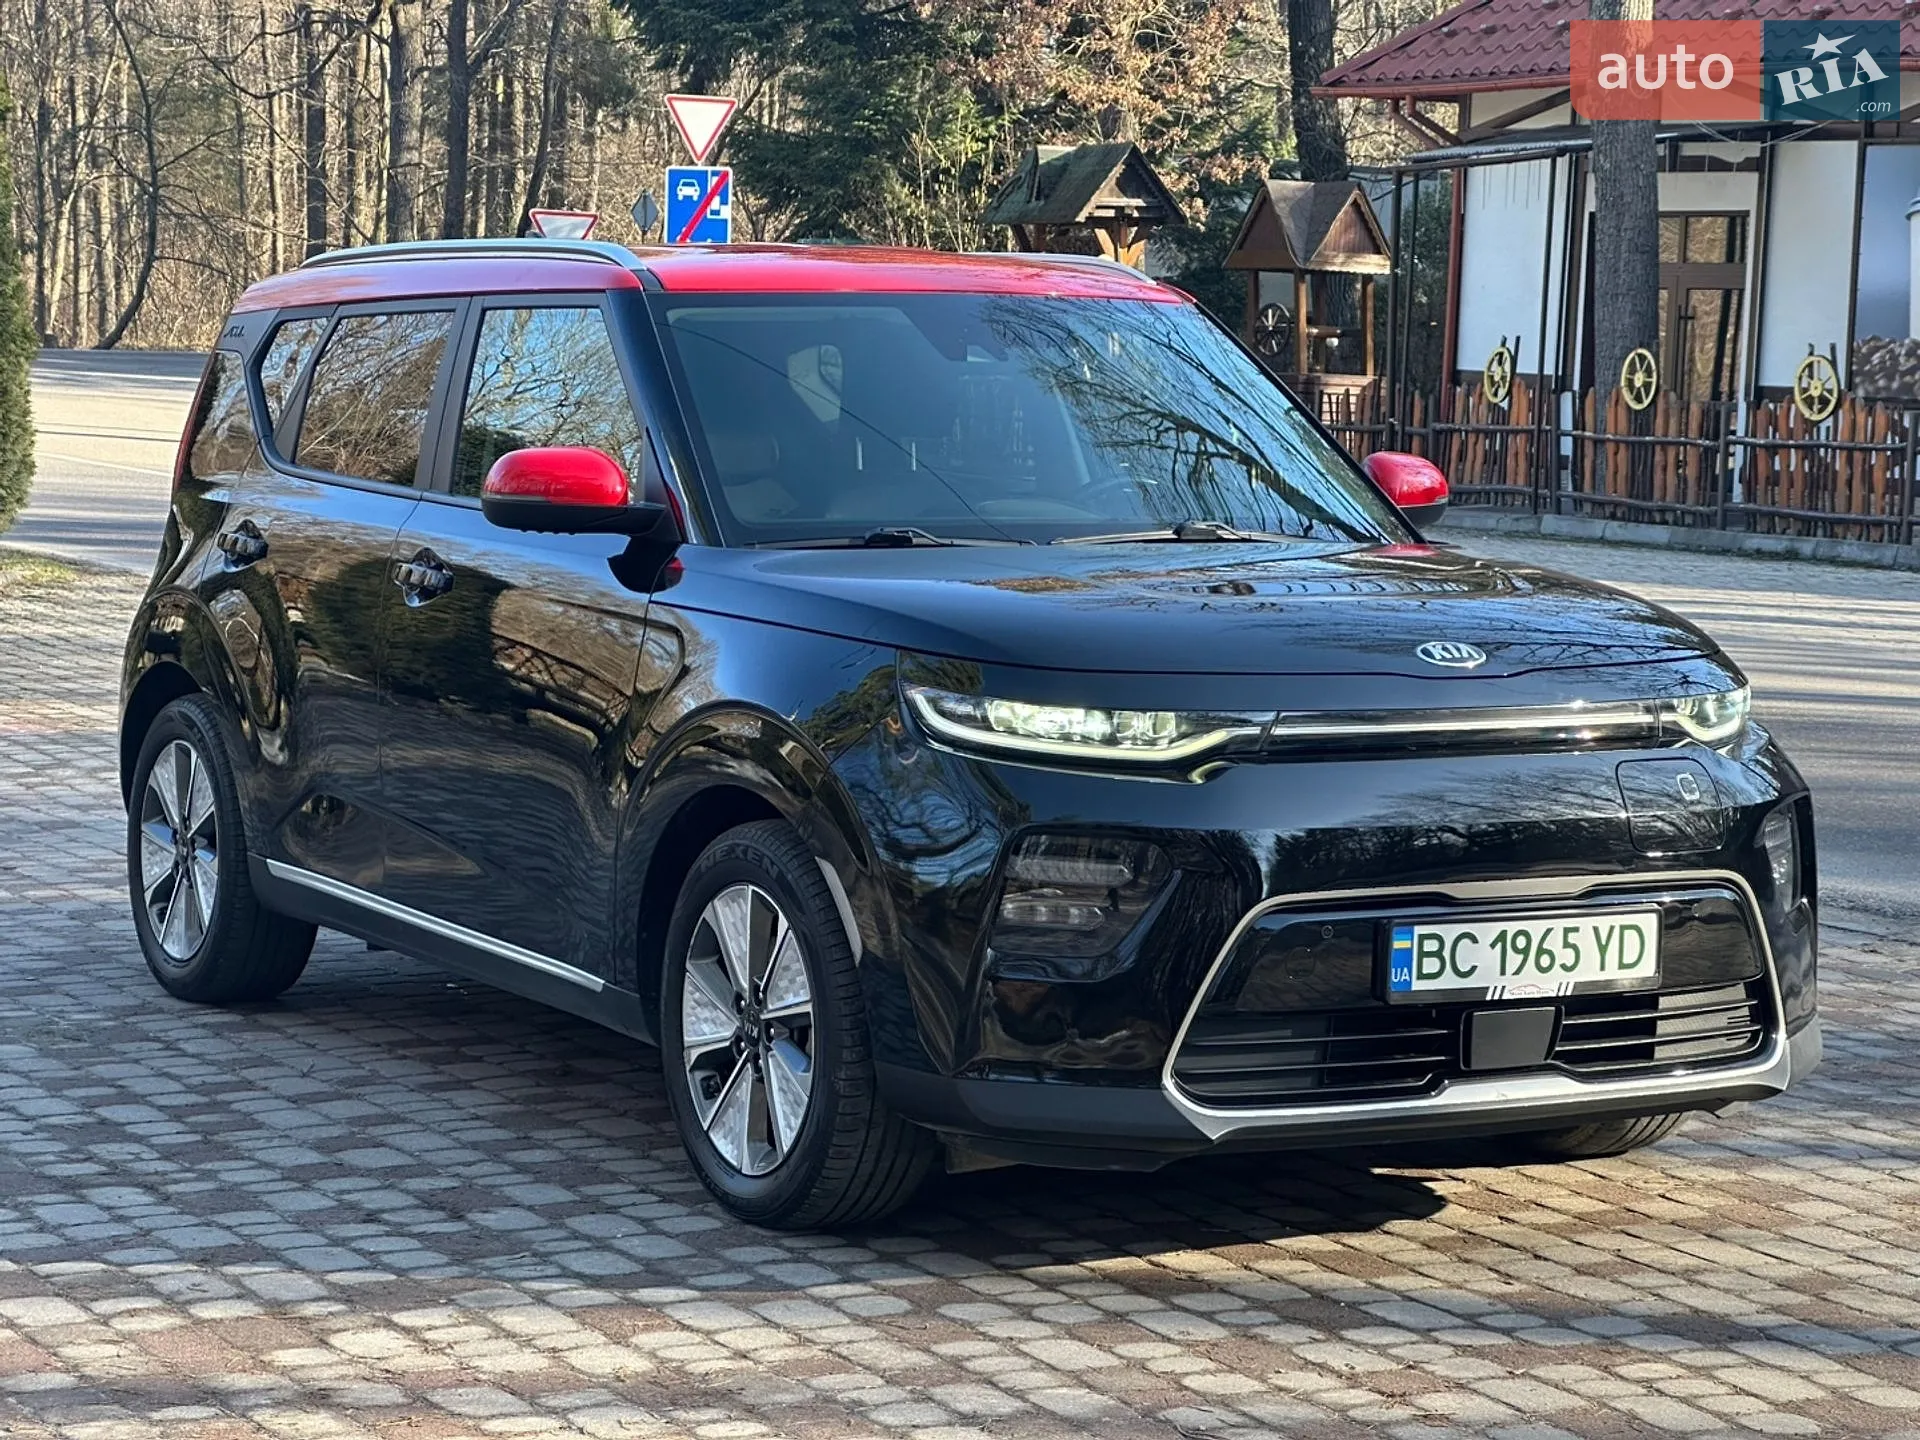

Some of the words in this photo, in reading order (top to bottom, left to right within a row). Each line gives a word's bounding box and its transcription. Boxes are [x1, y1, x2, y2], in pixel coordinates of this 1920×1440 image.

[1425, 643, 1480, 660] KIA
[700, 843, 780, 880] NEXEN
[1416, 931, 1479, 981] BC
[1489, 926, 1581, 977] 1965
[1592, 924, 1646, 971] YD
[1391, 967, 1411, 984] UA
